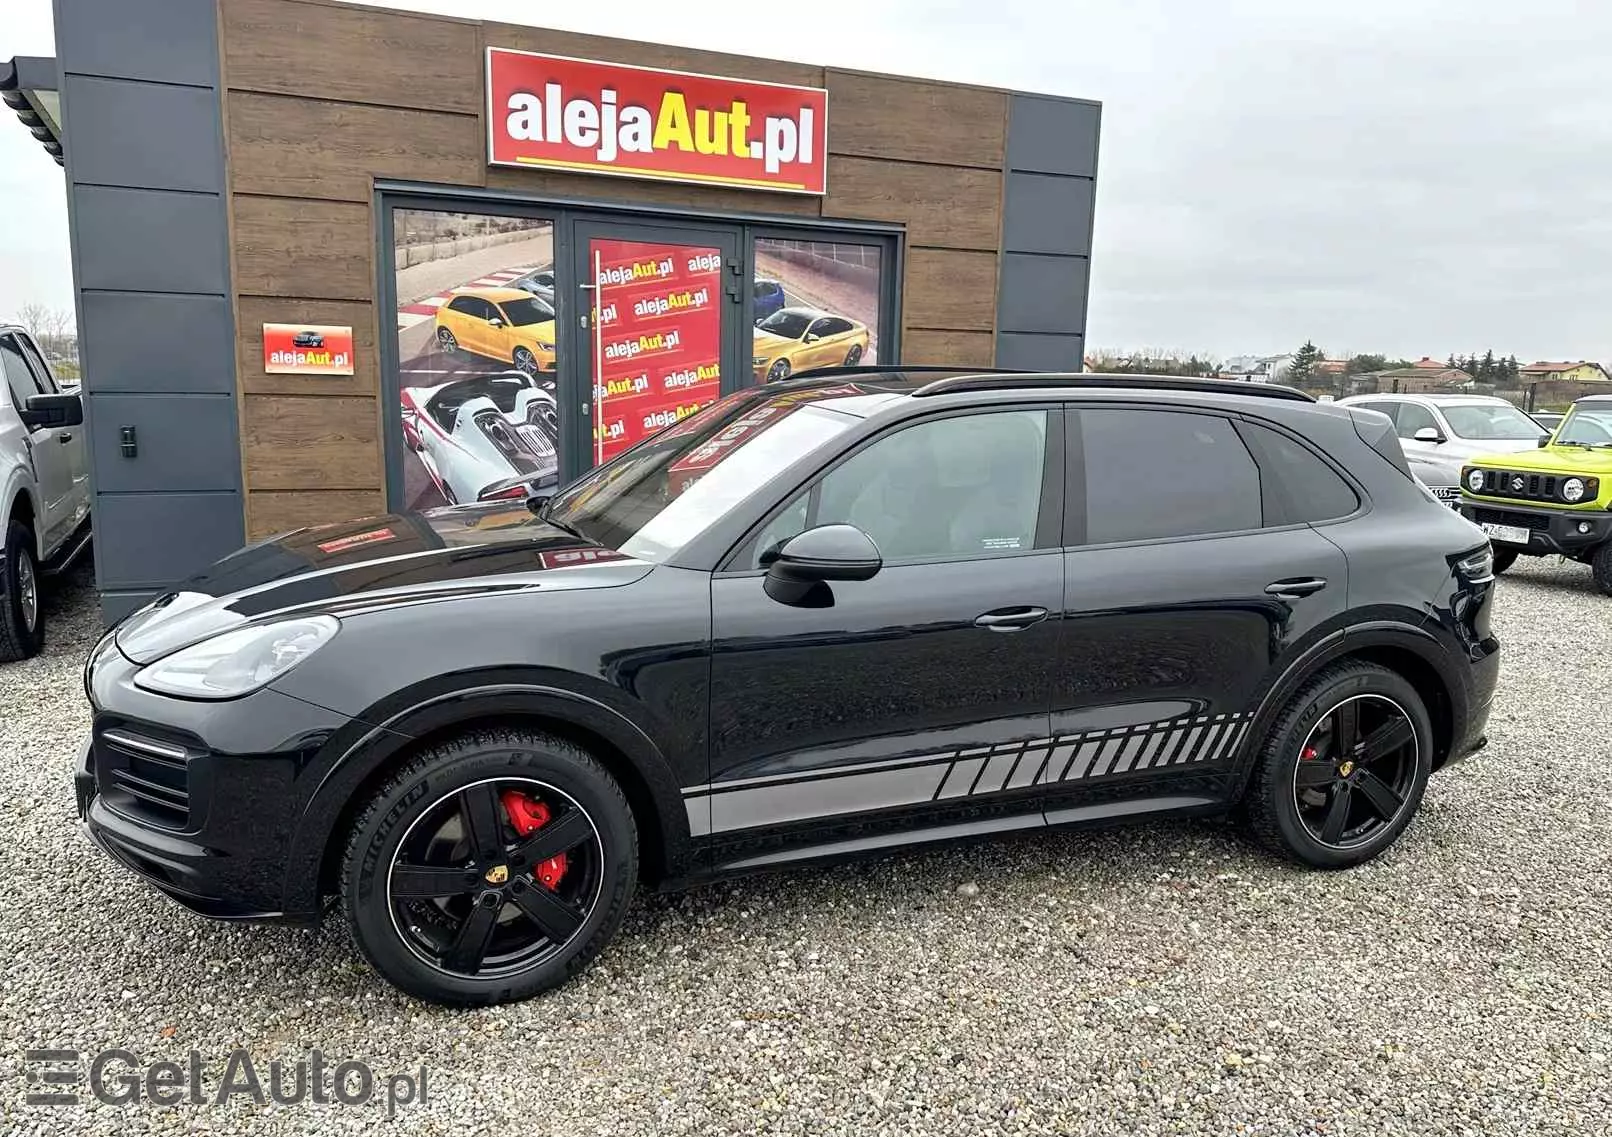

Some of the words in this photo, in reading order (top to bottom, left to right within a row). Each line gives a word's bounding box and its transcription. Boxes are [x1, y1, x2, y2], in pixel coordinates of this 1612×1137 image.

[506, 82, 814, 174] alejaAut.pl
[600, 258, 674, 285] alejaAut.pl
[634, 288, 708, 315] alejaAut.pl
[605, 330, 680, 358] alejaAut.pl
[270, 350, 348, 368] alejaAut.pl
[664, 364, 720, 388] alejaAut
[361, 780, 430, 873] MICHELIN
